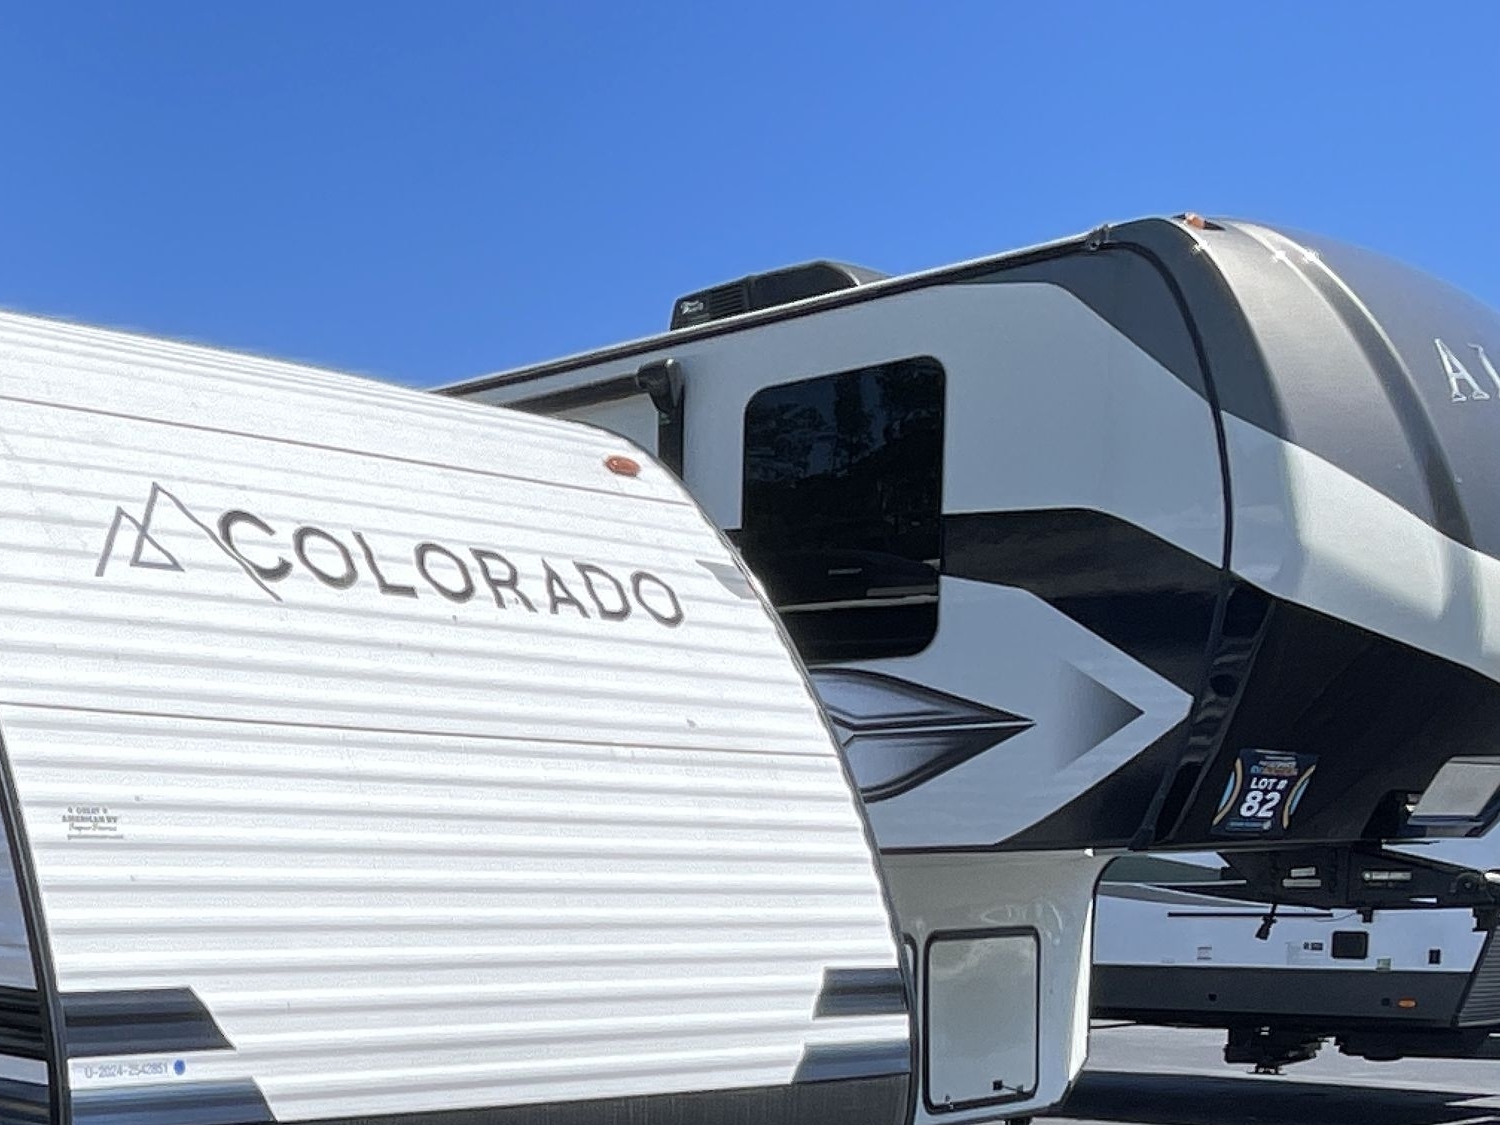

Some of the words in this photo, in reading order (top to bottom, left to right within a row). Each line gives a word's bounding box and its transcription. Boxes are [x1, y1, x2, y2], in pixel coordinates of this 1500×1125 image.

[216, 509, 684, 628] COLORADO
[1250, 777, 1277, 790] LOT
[1240, 790, 1281, 817] 82
